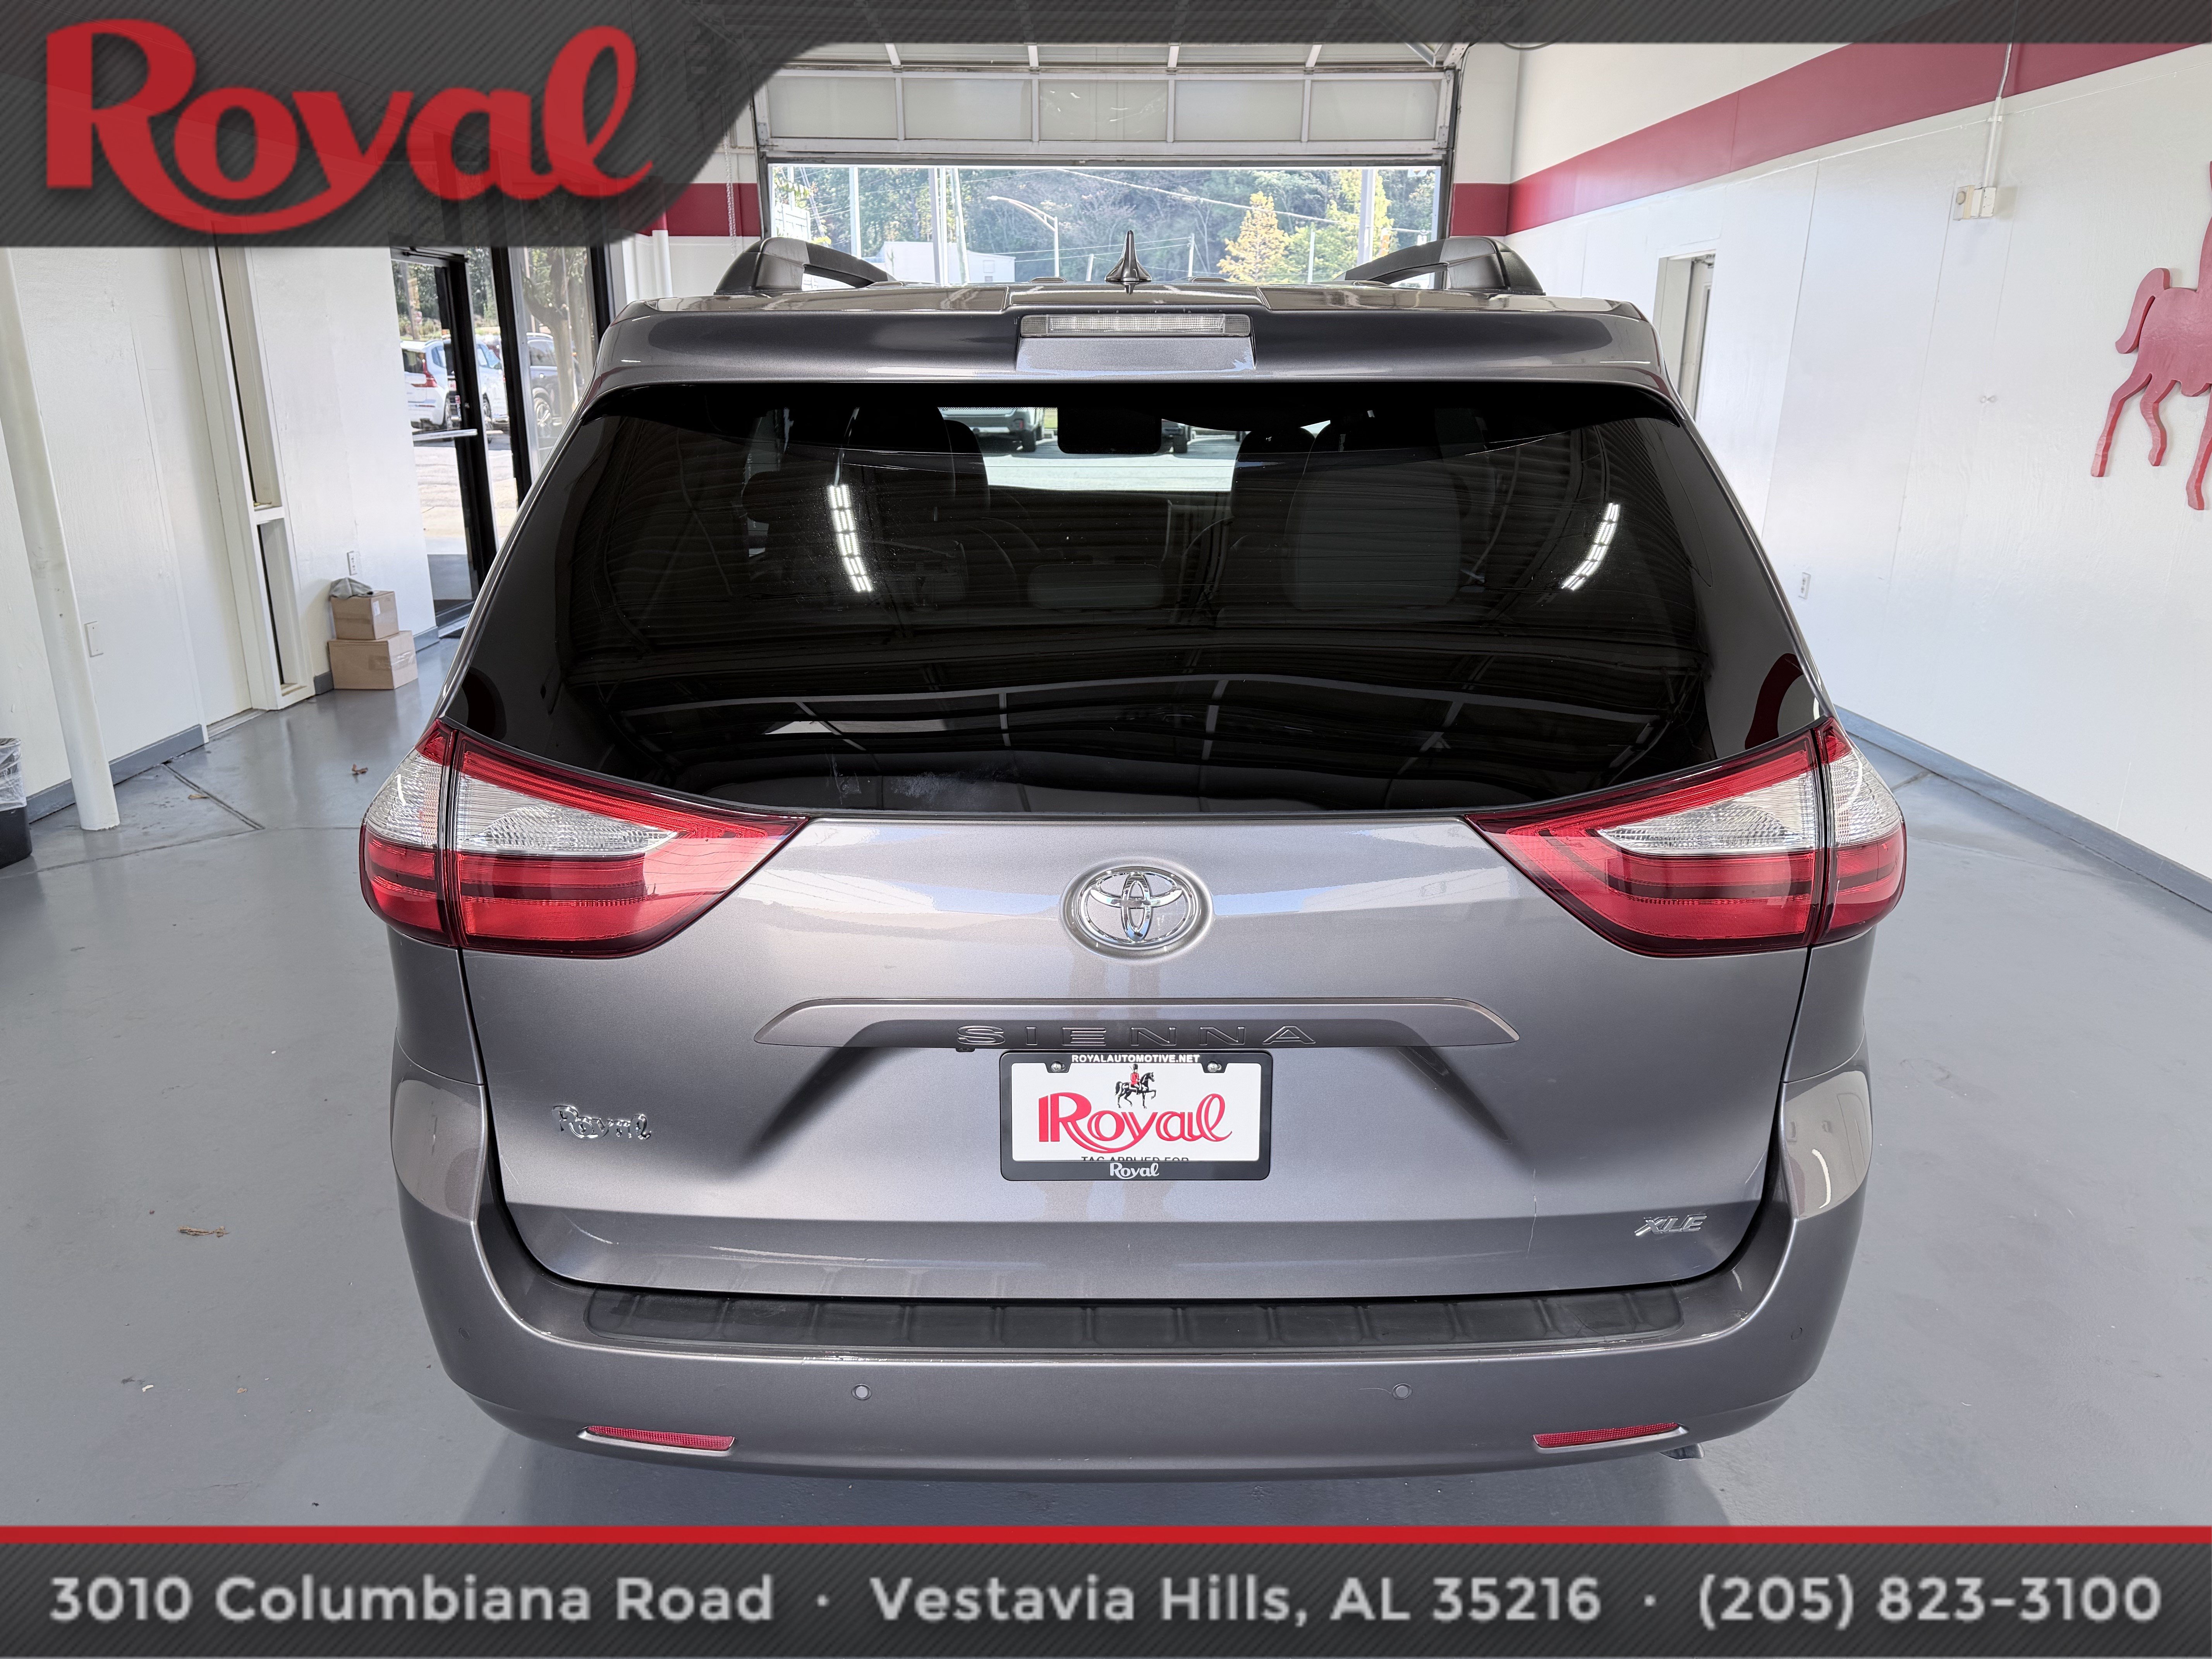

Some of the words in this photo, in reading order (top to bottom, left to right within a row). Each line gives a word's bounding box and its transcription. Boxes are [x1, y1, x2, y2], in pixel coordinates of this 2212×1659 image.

[956, 1024, 1316, 1046] SIENNA
[1071, 1054, 1200, 1063] ROYALAUTOMOTIVE.NET
[551, 1105, 652, 1139] Royal
[1038, 1092, 1233, 1154] Royal
[1109, 1162, 1159, 1180] Royal
[1634, 1214, 1707, 1236] XLE
